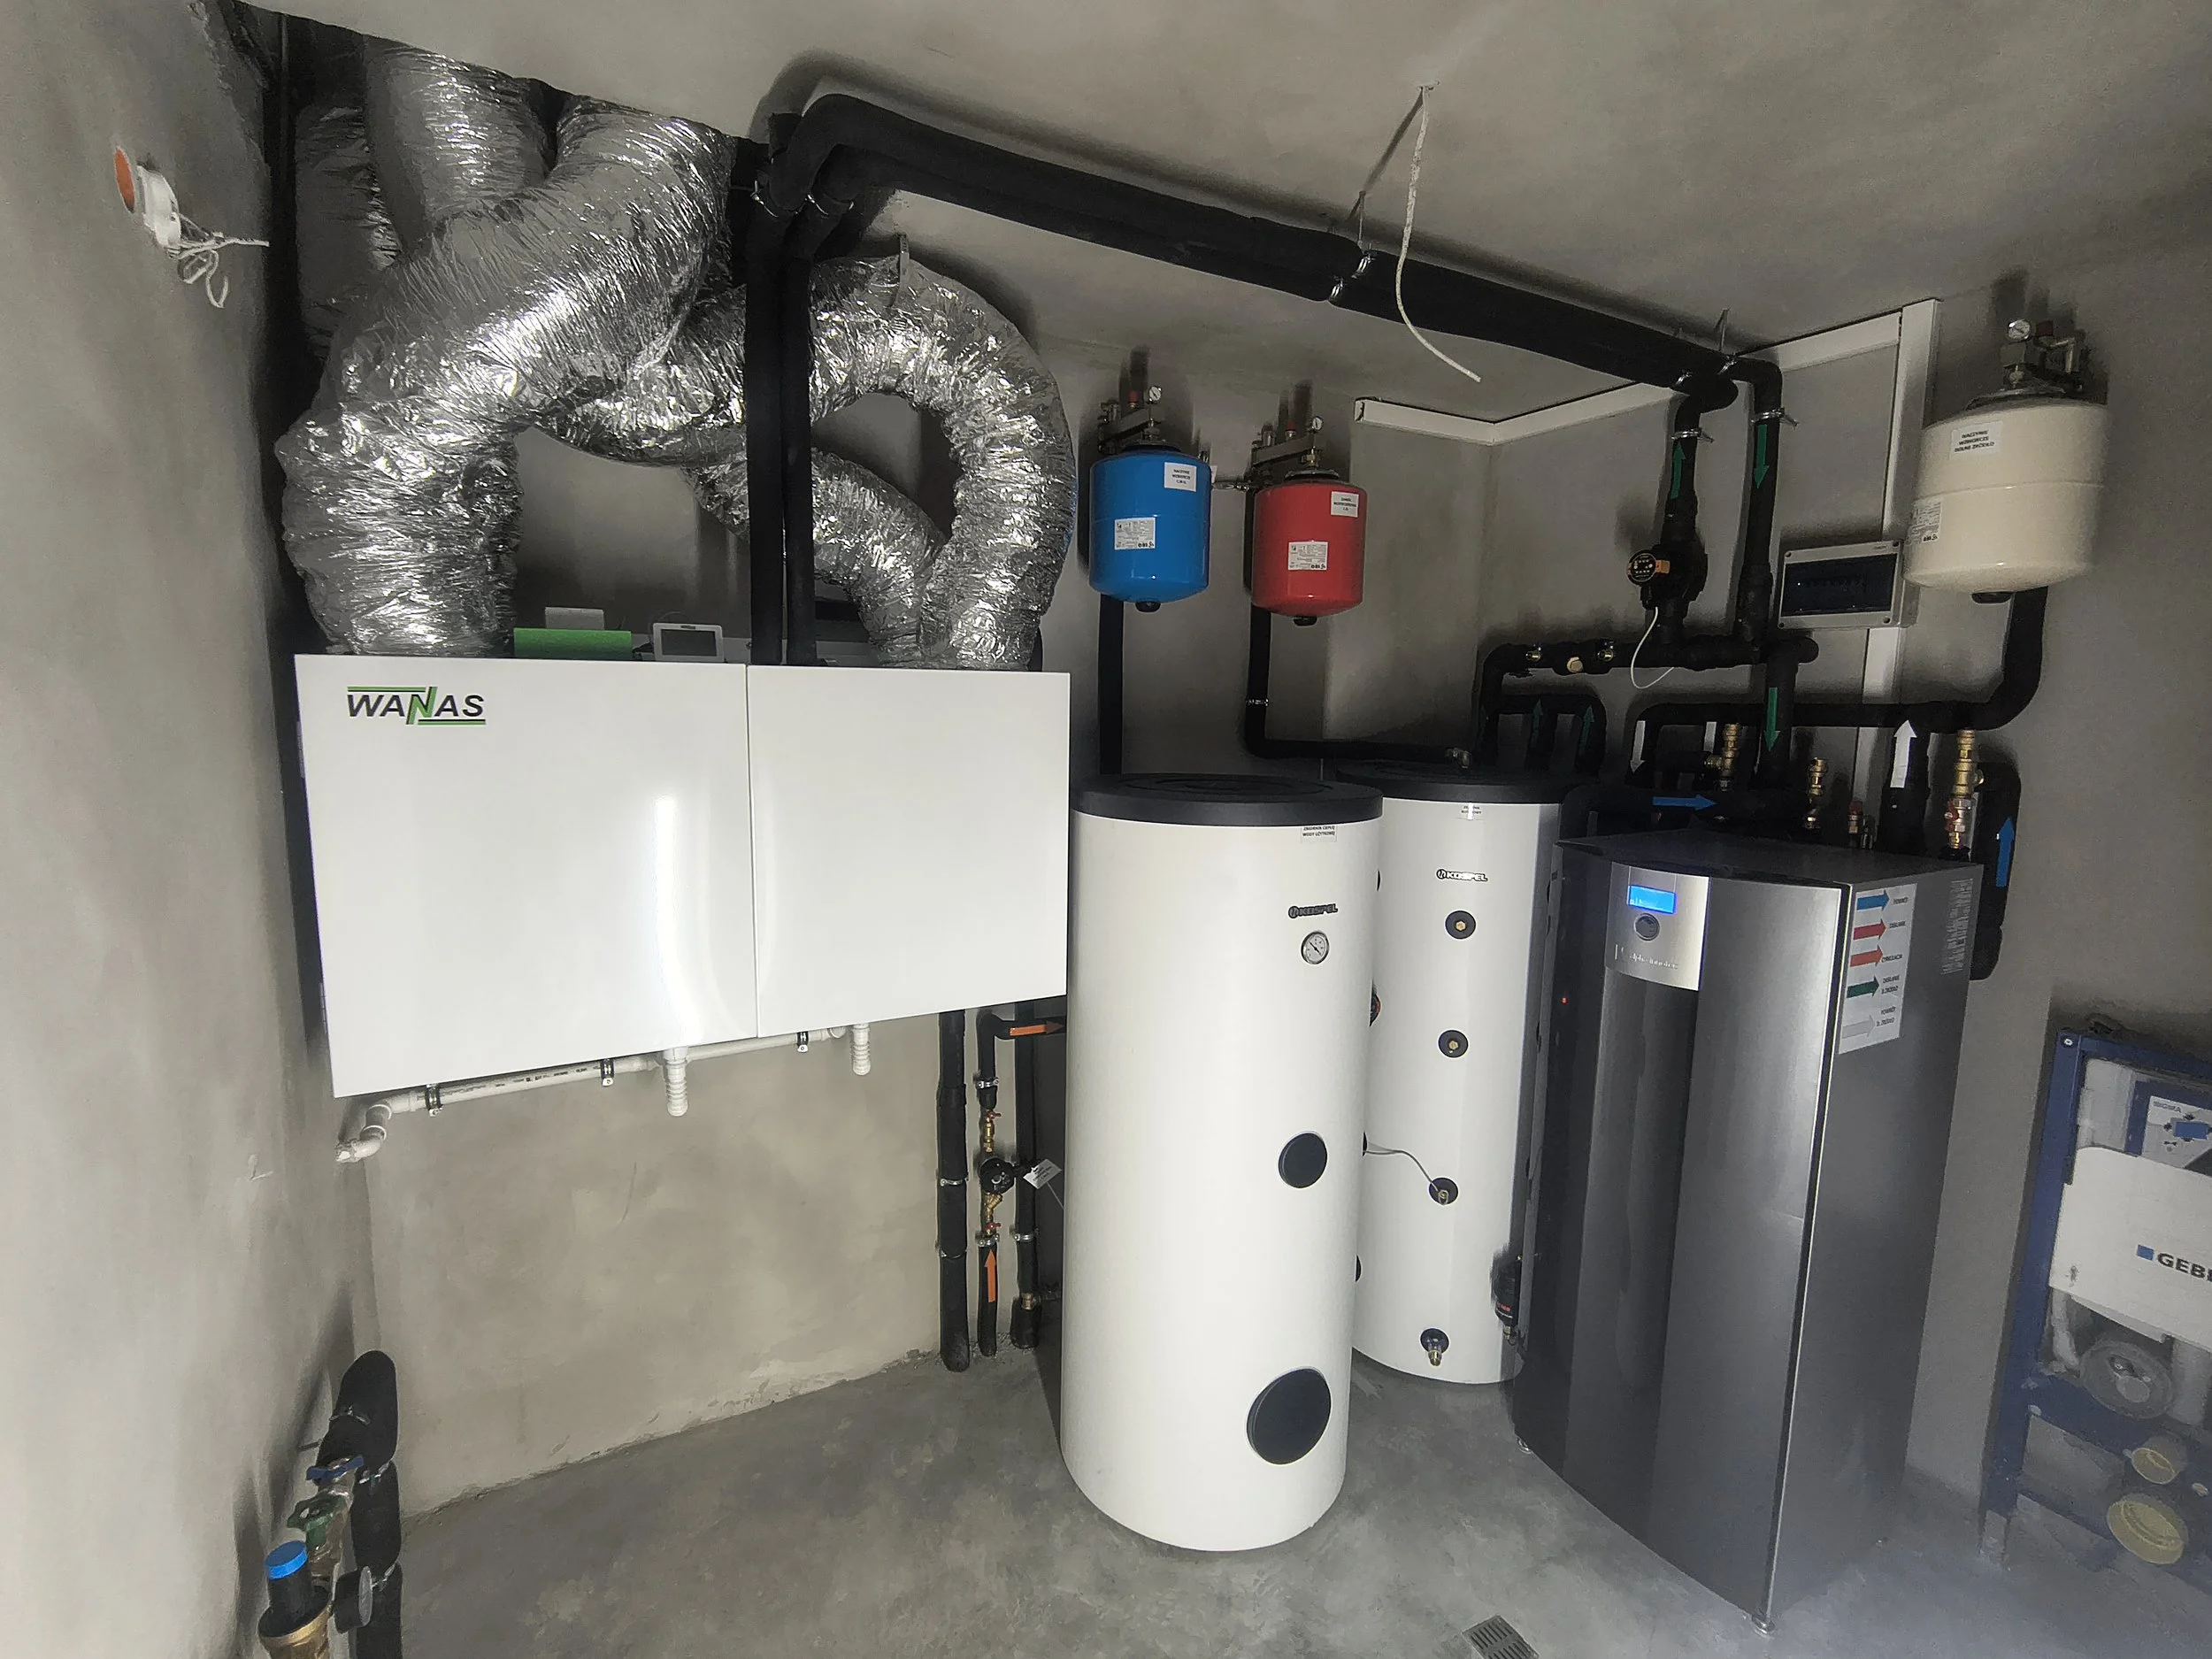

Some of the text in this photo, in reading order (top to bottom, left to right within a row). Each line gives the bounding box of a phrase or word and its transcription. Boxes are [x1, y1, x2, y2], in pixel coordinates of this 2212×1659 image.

[347, 687, 485, 725] WANAS
[1446, 871, 1488, 882] KOSPEL
[1299, 903, 1338, 917] KOSPEL
